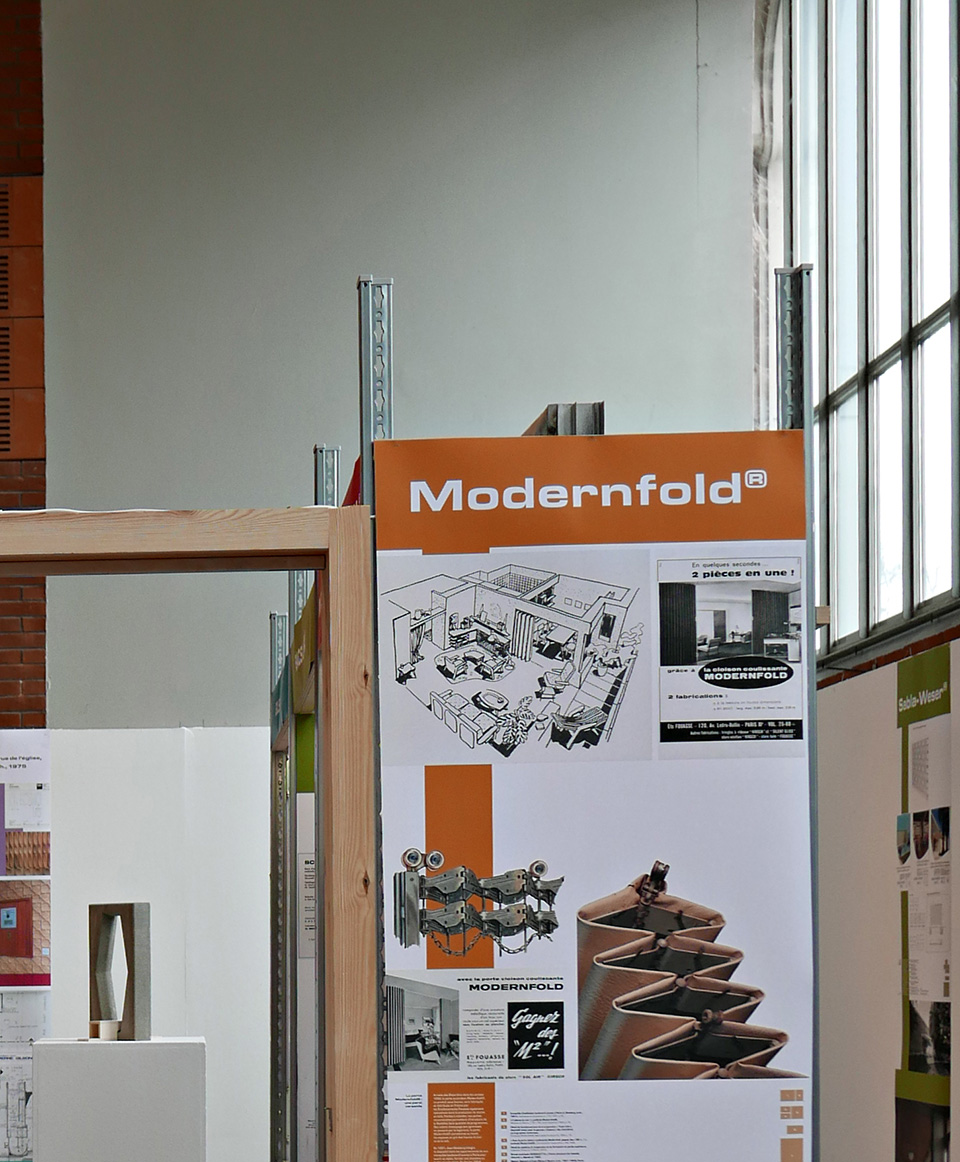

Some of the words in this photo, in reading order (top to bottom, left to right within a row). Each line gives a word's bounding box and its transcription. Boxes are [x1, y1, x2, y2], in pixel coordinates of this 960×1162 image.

[702, 561, 730, 569] quelques
[732, 560, 761, 568] secondes
[702, 569, 742, 579] pièces
[745, 569, 760, 577] en
[765, 569, 788, 577] une
[704, 672, 788, 681] MODERNFOLD
[469, 983, 564, 991] MODERNFOLD
